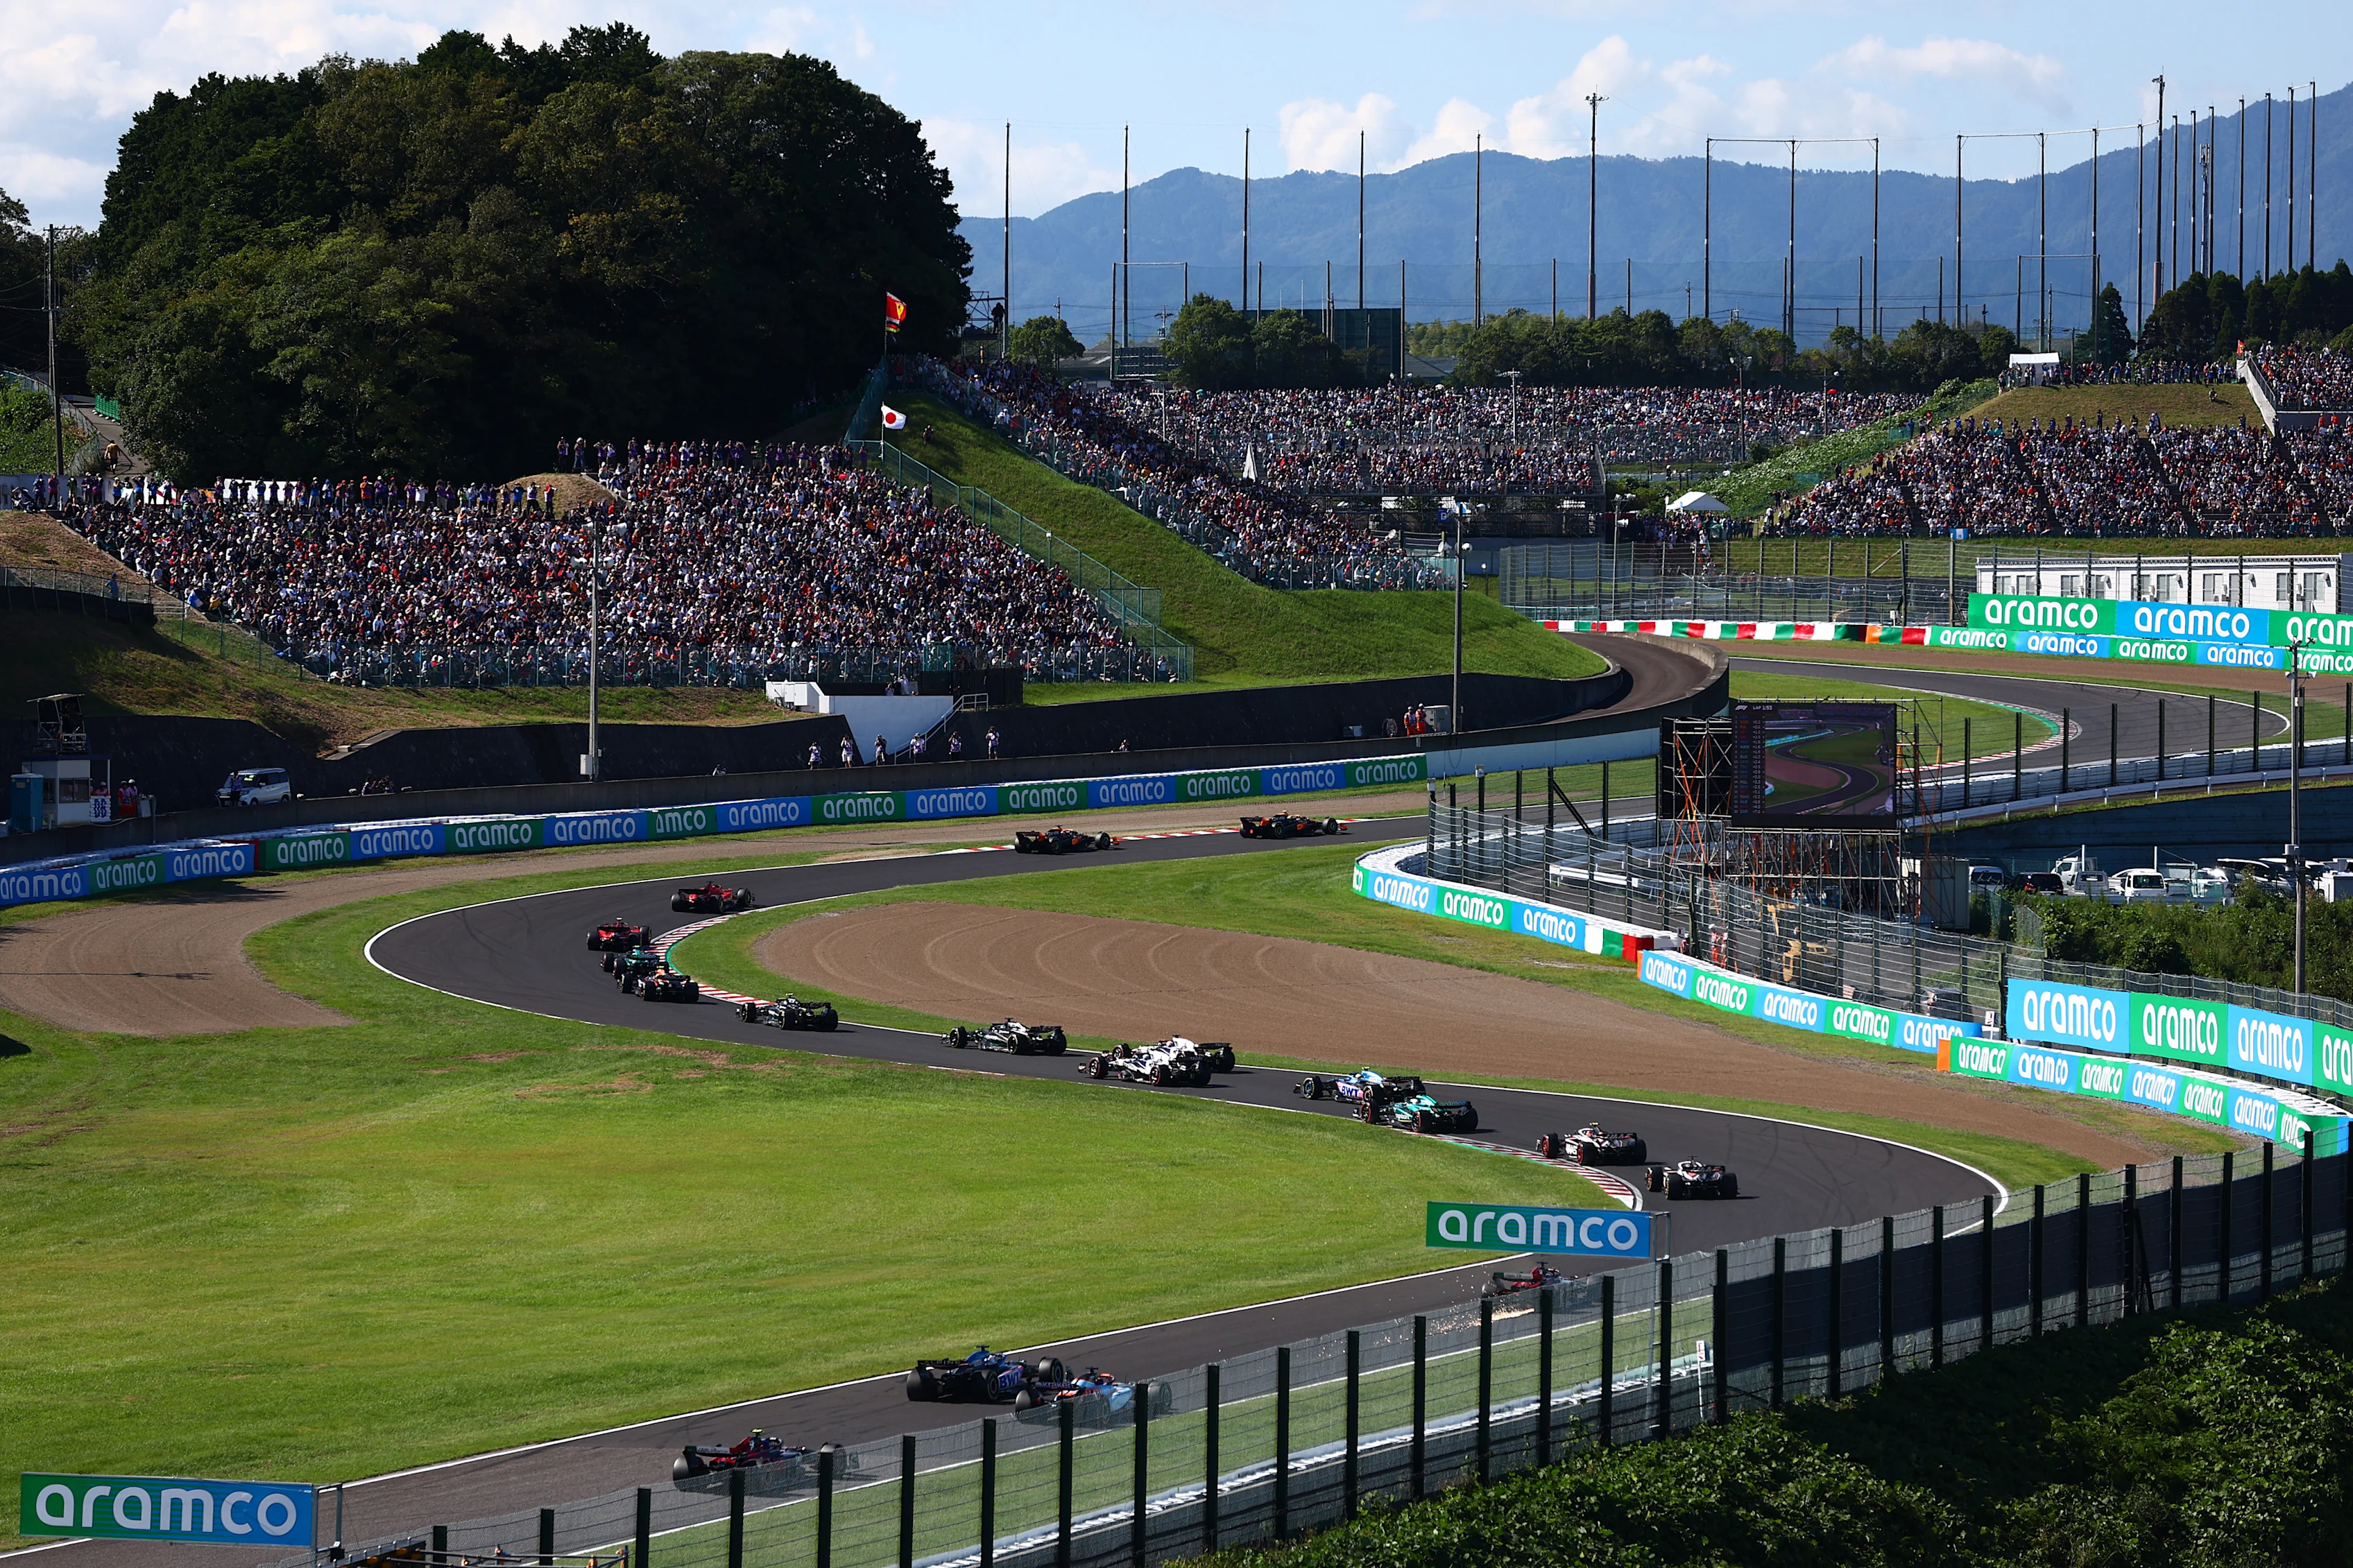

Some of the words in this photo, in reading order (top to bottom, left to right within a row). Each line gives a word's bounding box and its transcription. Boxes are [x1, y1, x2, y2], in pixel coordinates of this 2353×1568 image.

[1986, 599, 2098, 628] aramco
[2135, 607, 2250, 638] aramco
[1940, 628, 2007, 648] aramco
[2028, 634, 2098, 655] aramco
[2119, 638, 2187, 660] aramco
[2207, 646, 2273, 667] aramco
[1188, 775, 1250, 796] aramco
[1272, 769, 1335, 790] aramco
[1355, 761, 1417, 783] aramco
[917, 792, 986, 813] aramco
[1009, 788, 1077, 809] aramco
[1100, 782, 1165, 802] aramco
[728, 802, 798, 825] aramco
[823, 796, 894, 818] aramco
[360, 829, 433, 854] aramco
[455, 823, 531, 847] aramco
[555, 818, 635, 841] aramco
[173, 850, 245, 877] aramco
[278, 837, 344, 863] aramco
[1, 870, 80, 899] aramco
[96, 859, 156, 889] aramco
[1374, 876, 1429, 908] aramco
[1444, 891, 1503, 924] aramco
[1523, 908, 1575, 942] aramco
[1646, 957, 1686, 990] aramco
[1696, 974, 1747, 1010] aramco
[1764, 992, 1817, 1026] aramco
[1833, 1008, 1889, 1038] aramco
[2024, 990, 2116, 1042] aramco
[2143, 1003, 2217, 1055] aramco
[1958, 1043, 2006, 1074] aramco
[2238, 1017, 2302, 1073] aramco
[2018, 1053, 2068, 1085] aramco
[2082, 1063, 2122, 1094] aramco
[1341, 1085, 1359, 1096] BWT
[2132, 1071, 2175, 1105] aramco
[2184, 1083, 2223, 1118] aramco
[2234, 1096, 2275, 1132] aramco
[1438, 1210, 1638, 1250] aramco
[999, 1369, 1020, 1388] BWT
[35, 1483, 296, 1536] aramco
